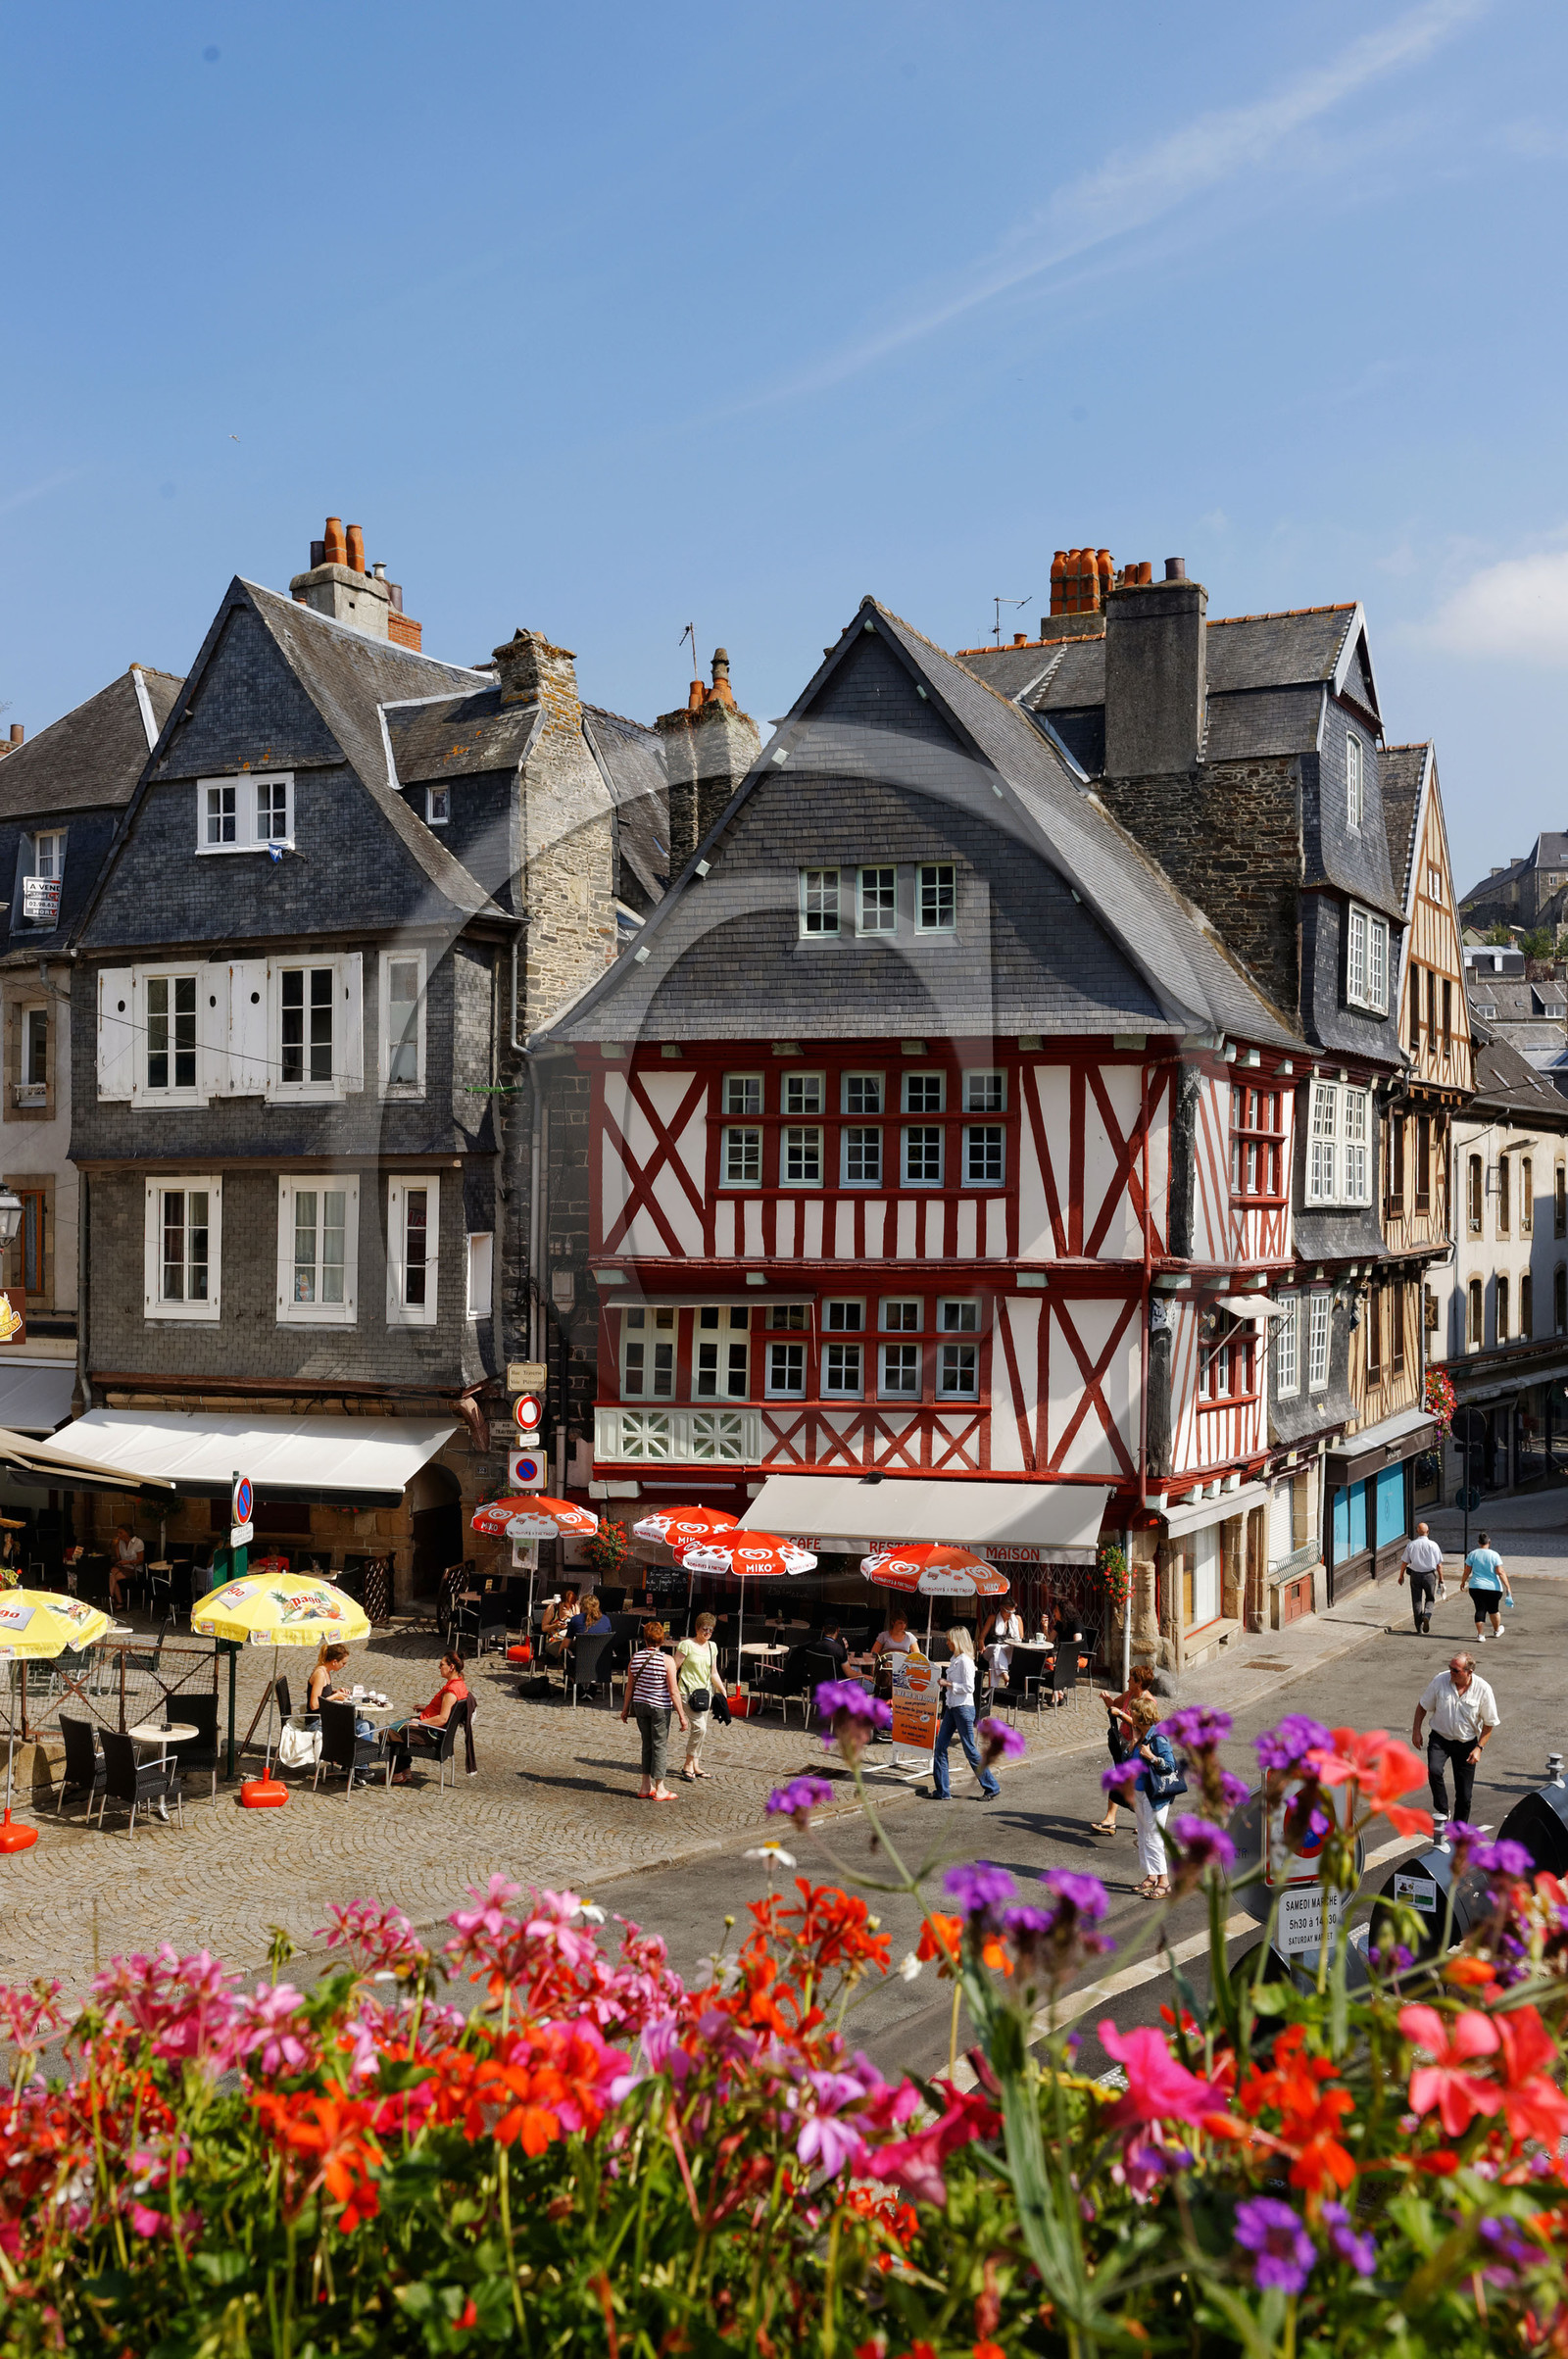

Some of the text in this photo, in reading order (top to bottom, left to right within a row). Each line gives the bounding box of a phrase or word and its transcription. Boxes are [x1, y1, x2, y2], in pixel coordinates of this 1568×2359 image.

[481, 1522, 498, 1532] MIKO
[986, 1547, 1040, 1561] MAISON
[746, 1563, 773, 1573] MIKO
[290, 1596, 321, 1607] pago
[1286, 1898, 1310, 1911] SAMEDI
[1289, 1917, 1307, 1930] 5h30
[1288, 1935, 1313, 1945] SATURDAY
